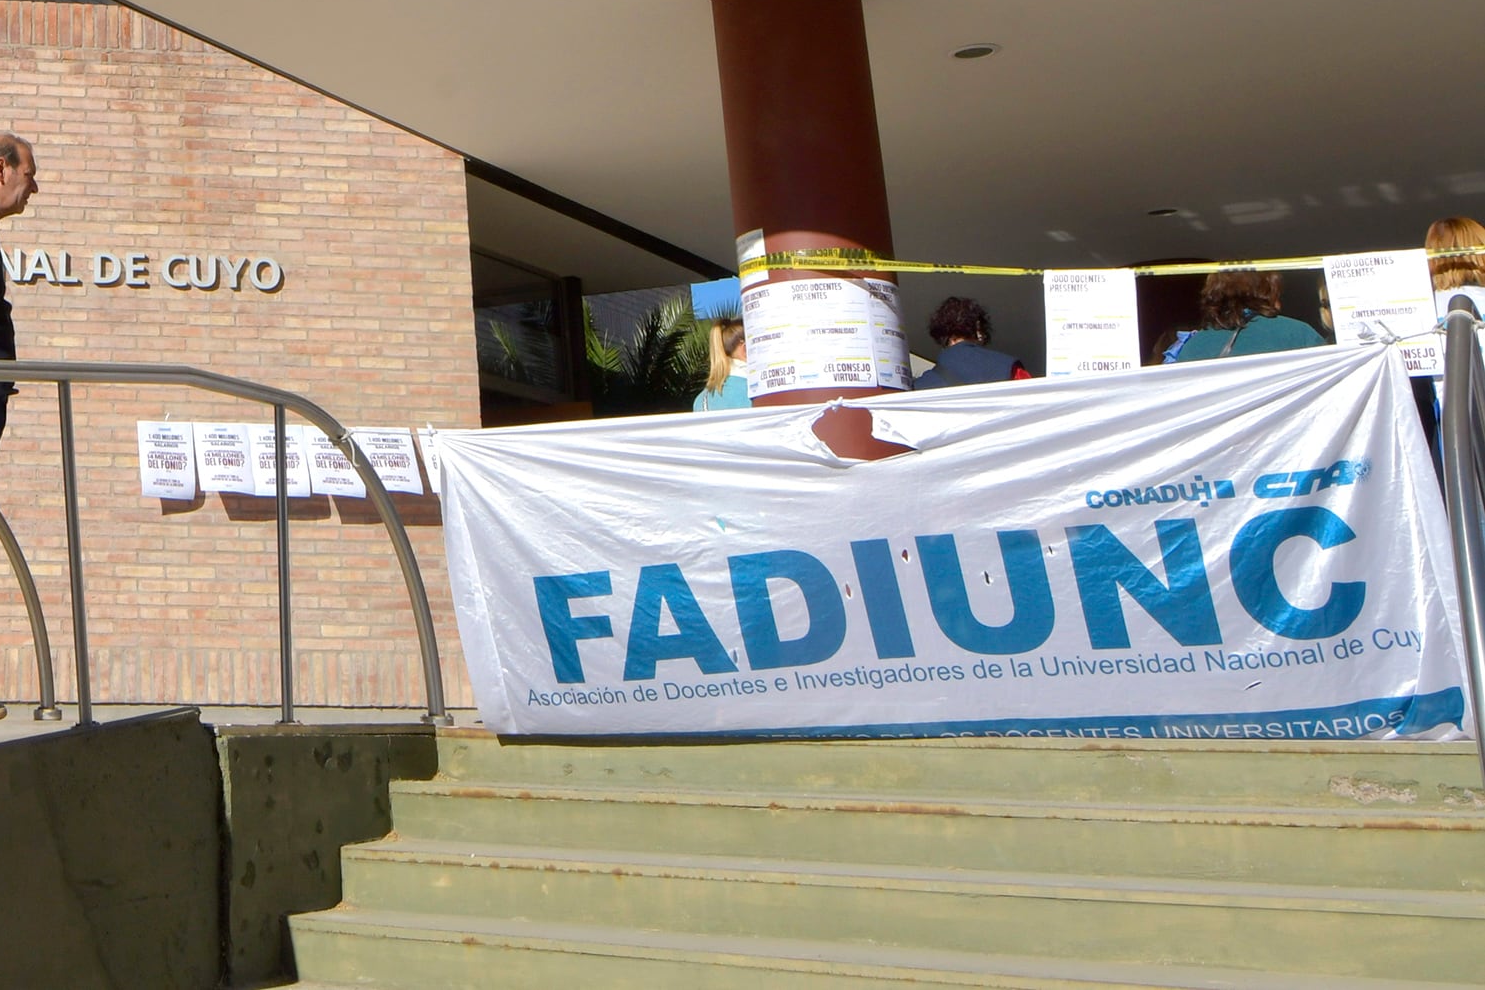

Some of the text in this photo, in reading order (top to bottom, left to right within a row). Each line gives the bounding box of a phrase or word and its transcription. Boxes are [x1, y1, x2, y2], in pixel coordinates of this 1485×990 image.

[93, 251, 148, 286] DE
[161, 253, 282, 291] CUYO
[1401, 347, 1436, 360] NSEJO
[836, 363, 871, 372] CONSEJO
[148, 460, 159, 469] DEL
[205, 457, 217, 467] DEL
[532, 506, 1367, 685] FADIUNC
[527, 686, 627, 707] Asociación
[632, 685, 658, 703] de
[663, 677, 767, 701] Docentes
[774, 677, 789, 692] e
[795, 663, 965, 691] Investigadores
[972, 659, 1004, 679] de
[1009, 658, 1033, 678] la
[1040, 652, 1197, 678] Universidad
[1205, 641, 1326, 672] Nacional
[1333, 637, 1365, 660] de
[1150, 709, 1405, 739] UNIVERSITARIOS
